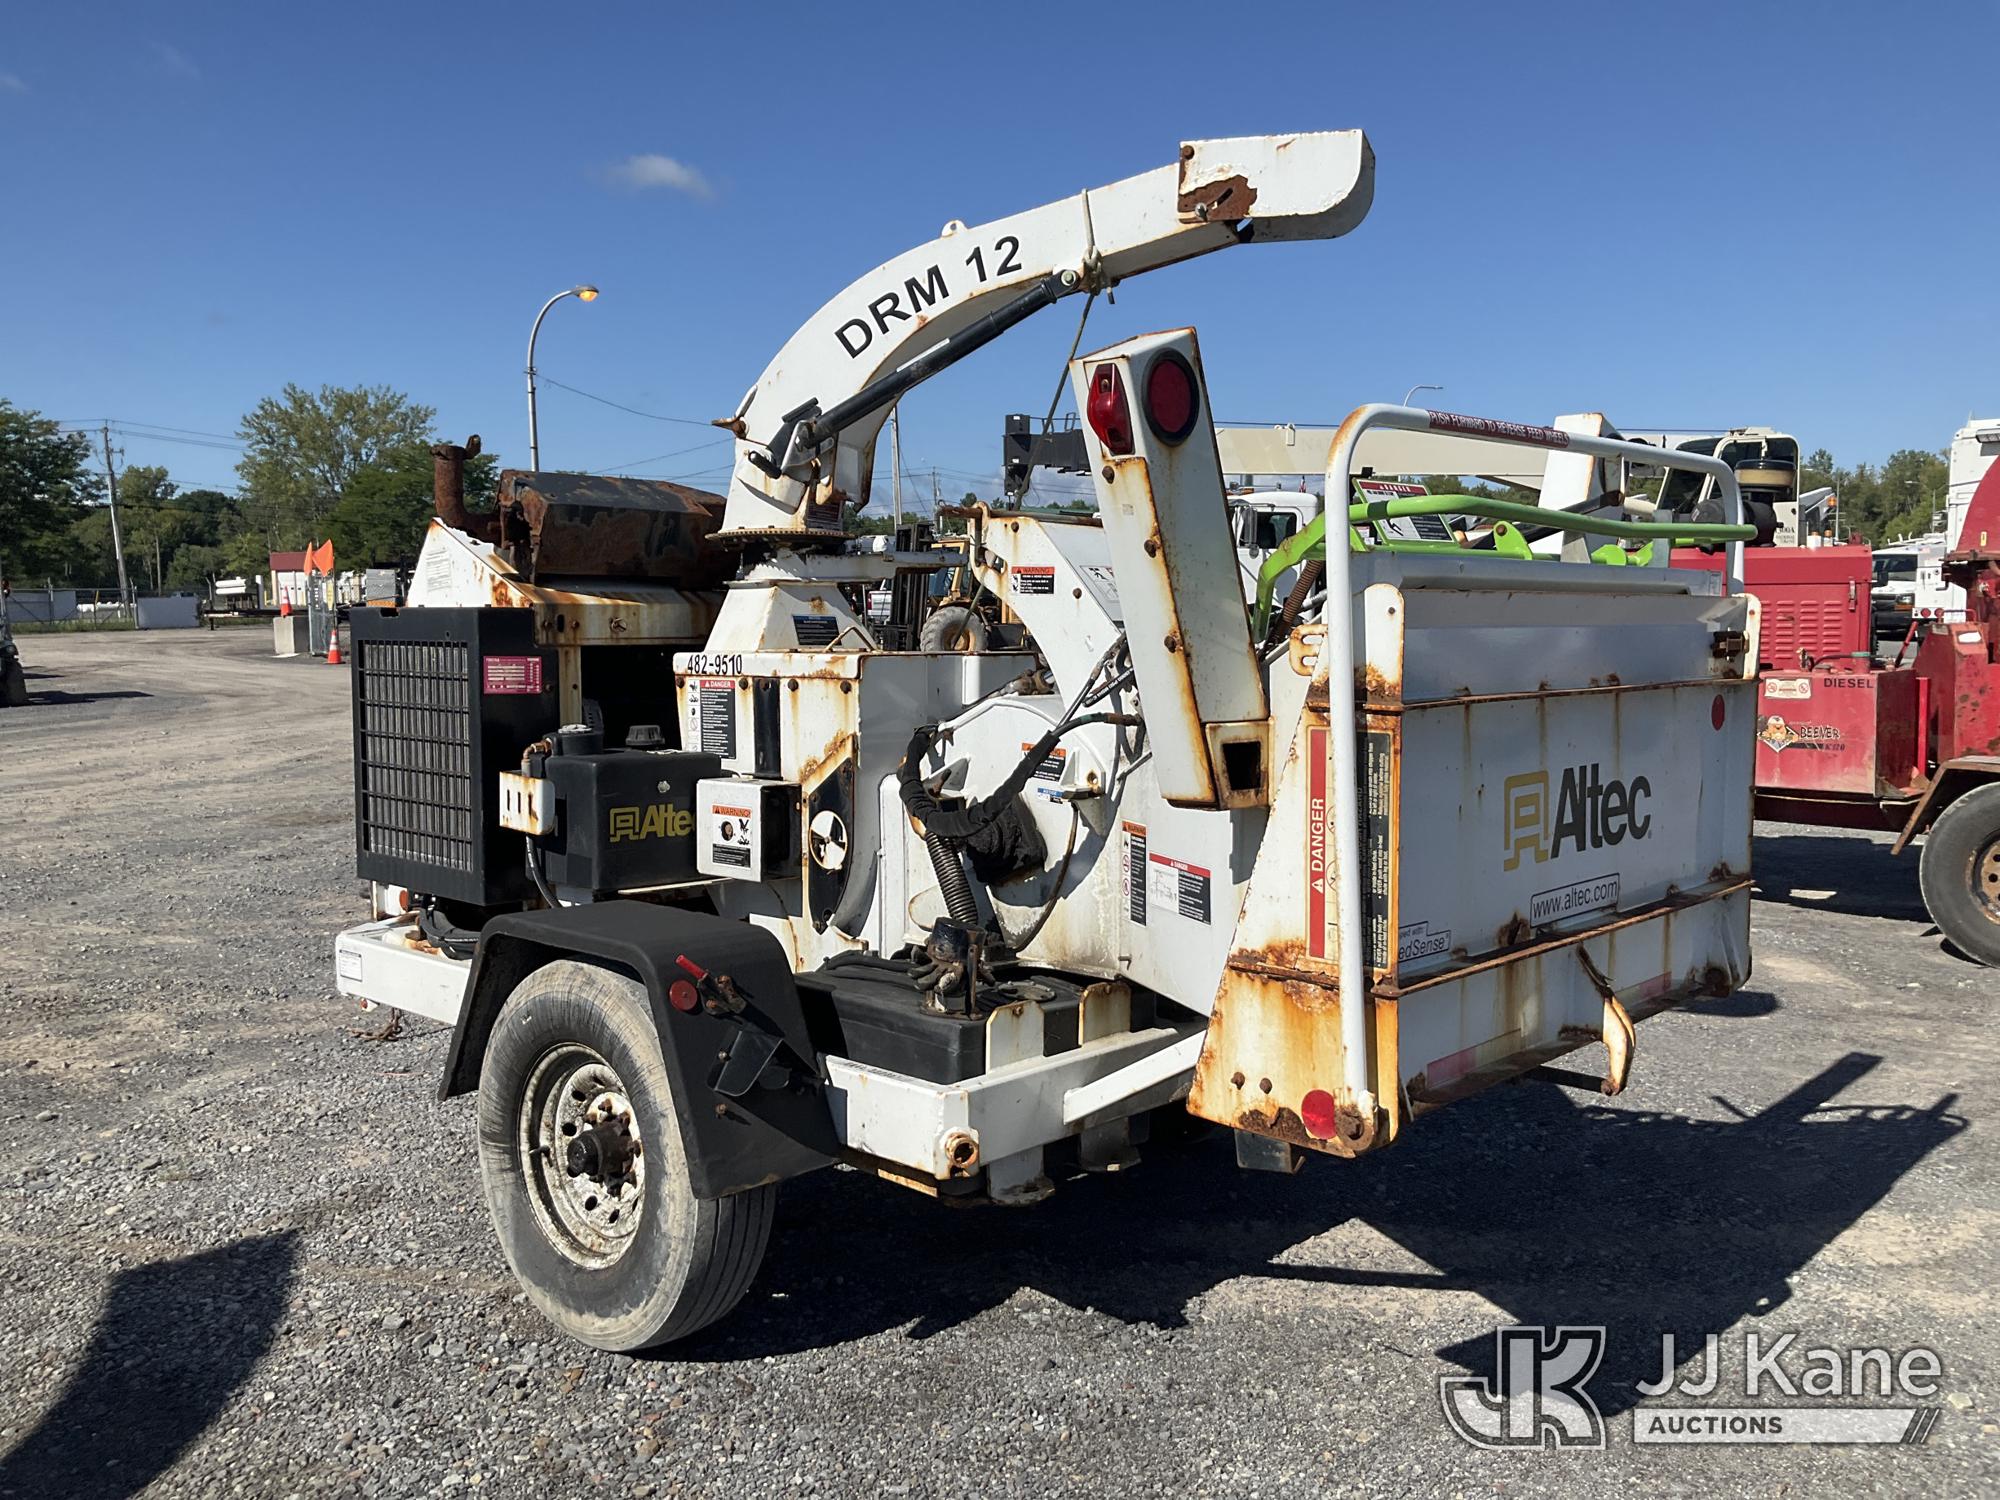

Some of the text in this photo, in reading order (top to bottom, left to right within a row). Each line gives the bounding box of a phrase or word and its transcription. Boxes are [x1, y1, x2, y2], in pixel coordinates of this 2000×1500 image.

[834, 235, 1022, 359] DRM 12
[1429, 411, 1569, 446] PUSH FORWARD TO REVERSE FEED WHEELS
[687, 654, 743, 675] 482-9510
[1824, 677, 1874, 689] DIESEL
[710, 680, 731, 688] DANGER
[640, 803, 695, 840] Alte
[1551, 763, 1652, 860] Altec
[1312, 798, 1325, 872] DANGER
[1532, 880, 1618, 919] www.altec.com
